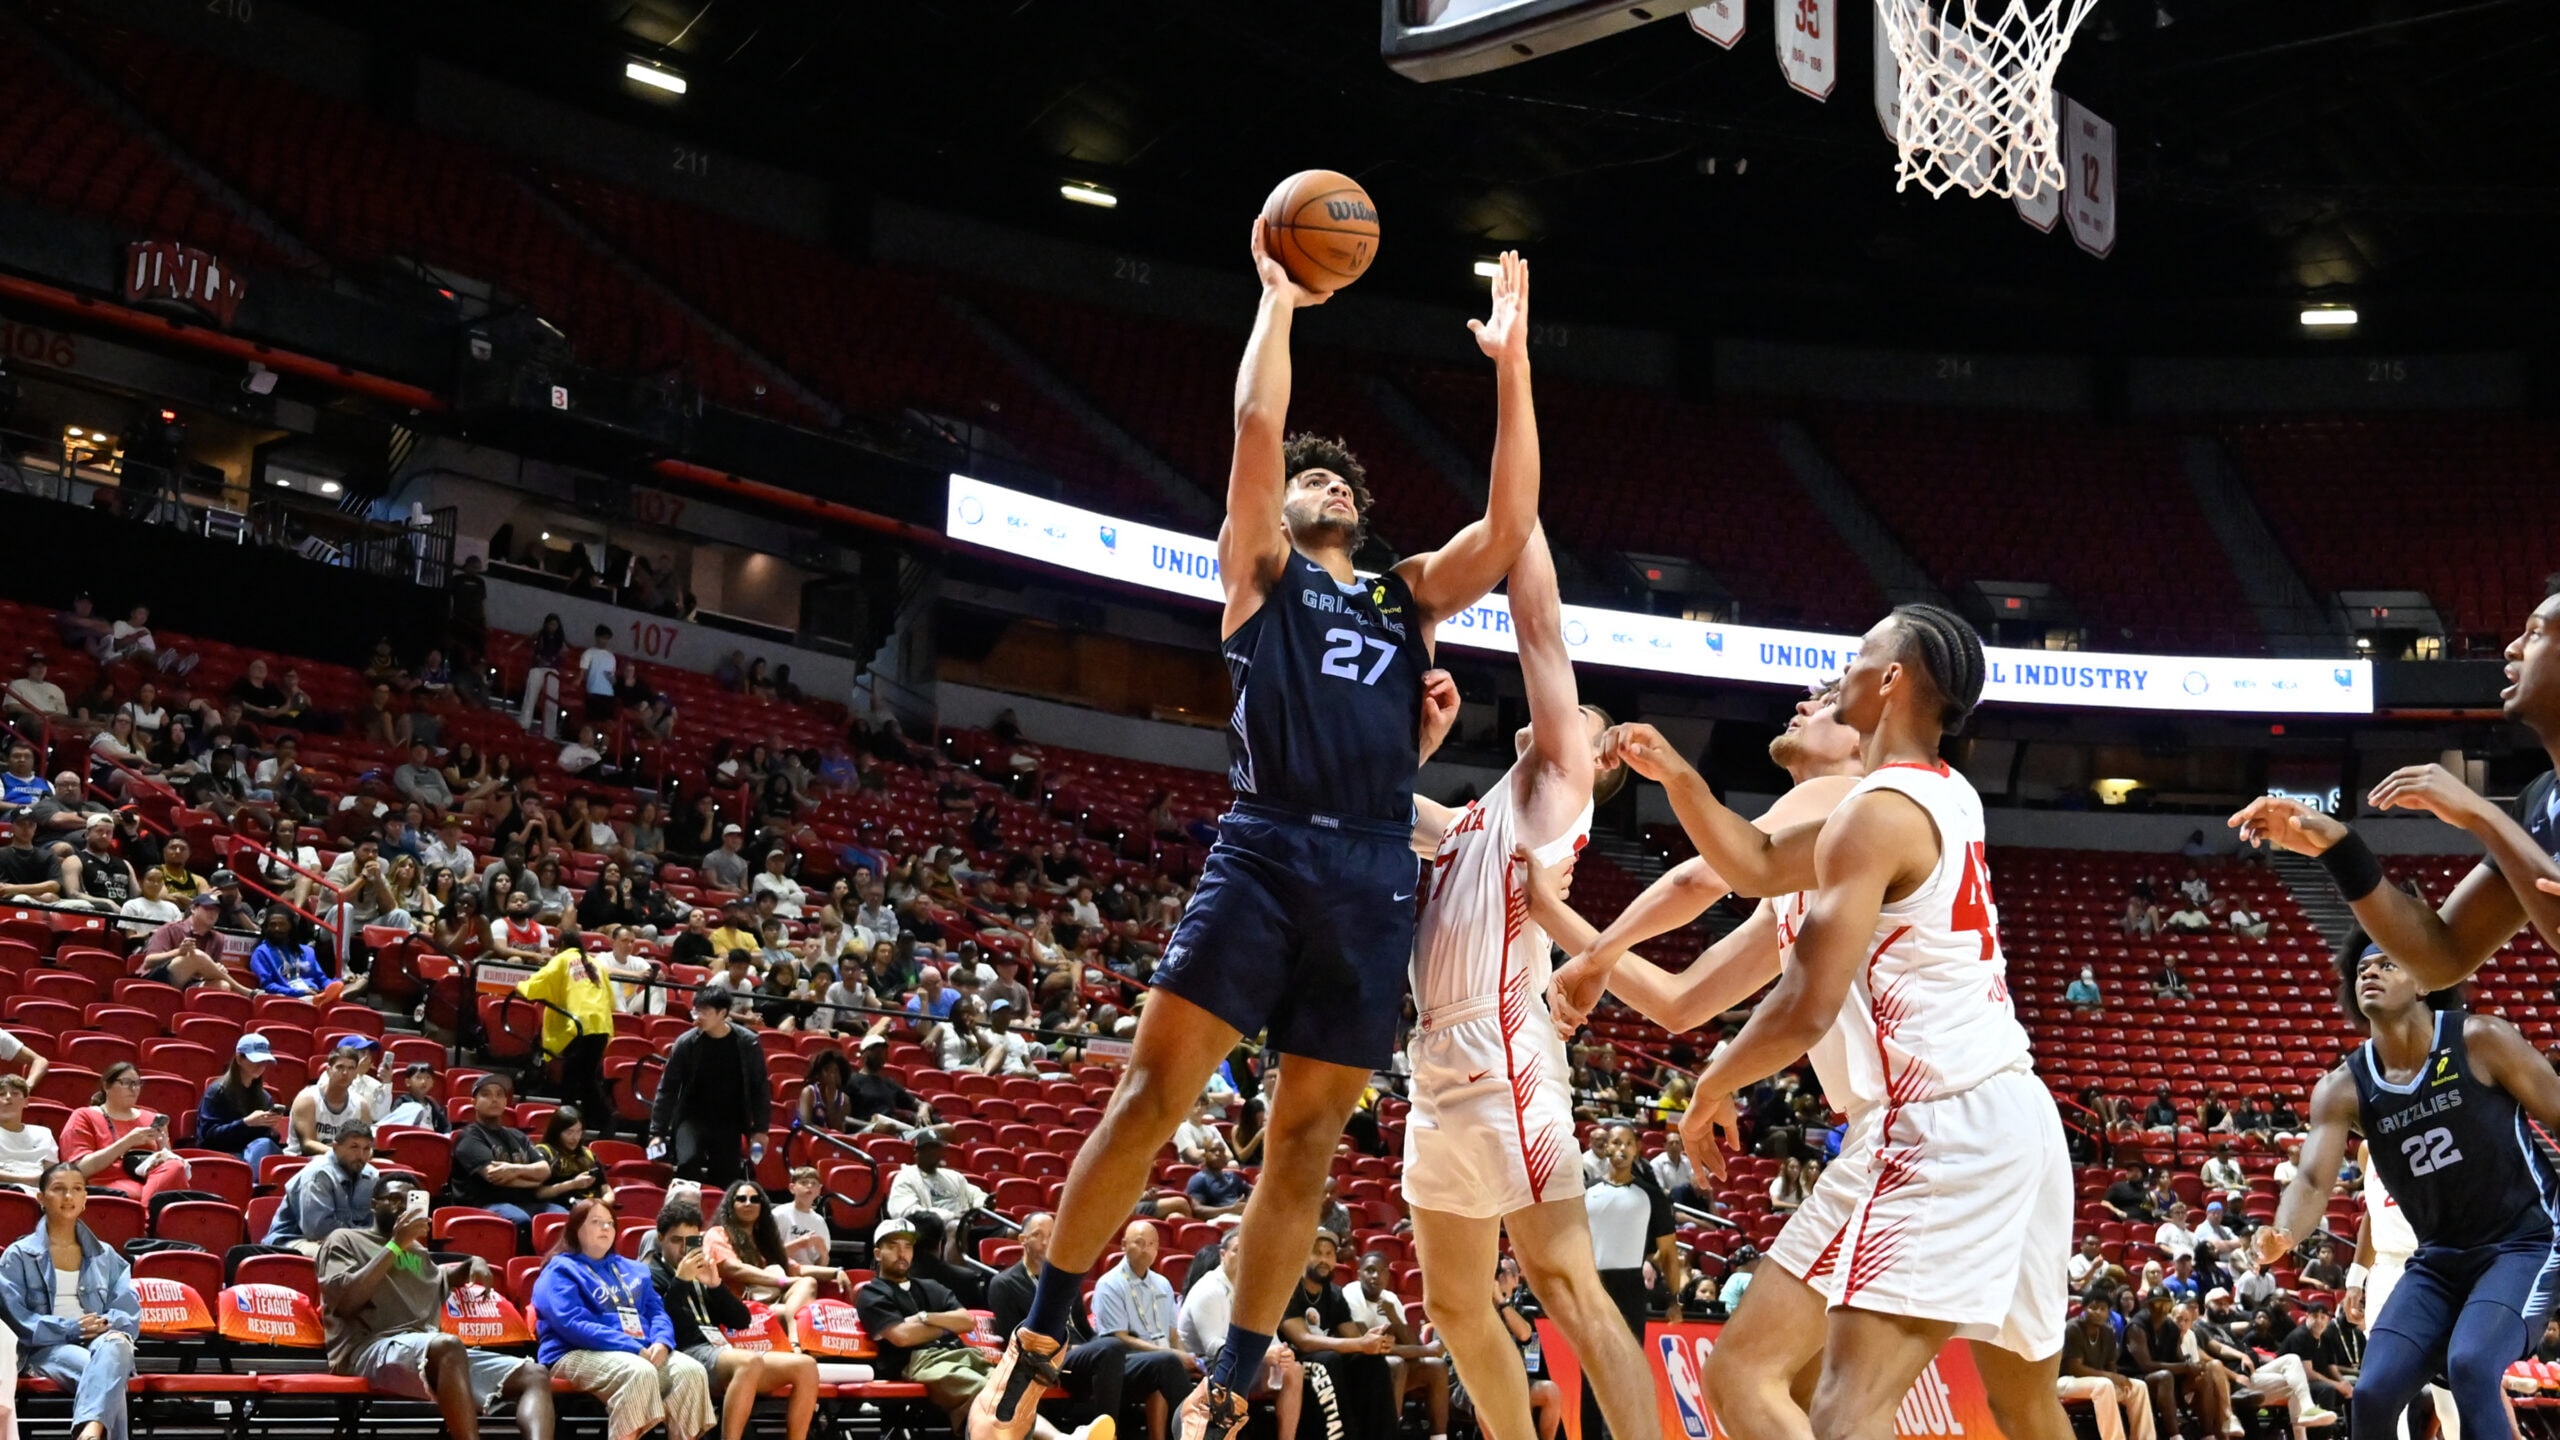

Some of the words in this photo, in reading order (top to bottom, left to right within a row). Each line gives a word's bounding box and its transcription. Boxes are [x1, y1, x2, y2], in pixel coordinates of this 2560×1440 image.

[672, 146, 709, 177] 211
[2082, 152, 2100, 204] 12
[1113, 257, 1151, 285] 212
[2, 322, 76, 368] 106
[1936, 358, 1973, 379] 214
[2367, 360, 2407, 382] 215
[553, 389, 565, 407] 3
[630, 619, 678, 660] 107
[1321, 628, 1398, 686] 27
[1759, 643, 1836, 671] UNION
[2015, 663, 2149, 691] INDUSTRY
[2401, 1126, 2464, 1178] 22
[144, 1282, 185, 1301] LEAGUE
[257, 1299, 295, 1317] LEAGUE
[464, 1302, 502, 1318] LEAGUE
[248, 1317, 296, 1337] RESERVED
[459, 1322, 503, 1337] RESERVED
[822, 1335, 860, 1350] RESERVED
